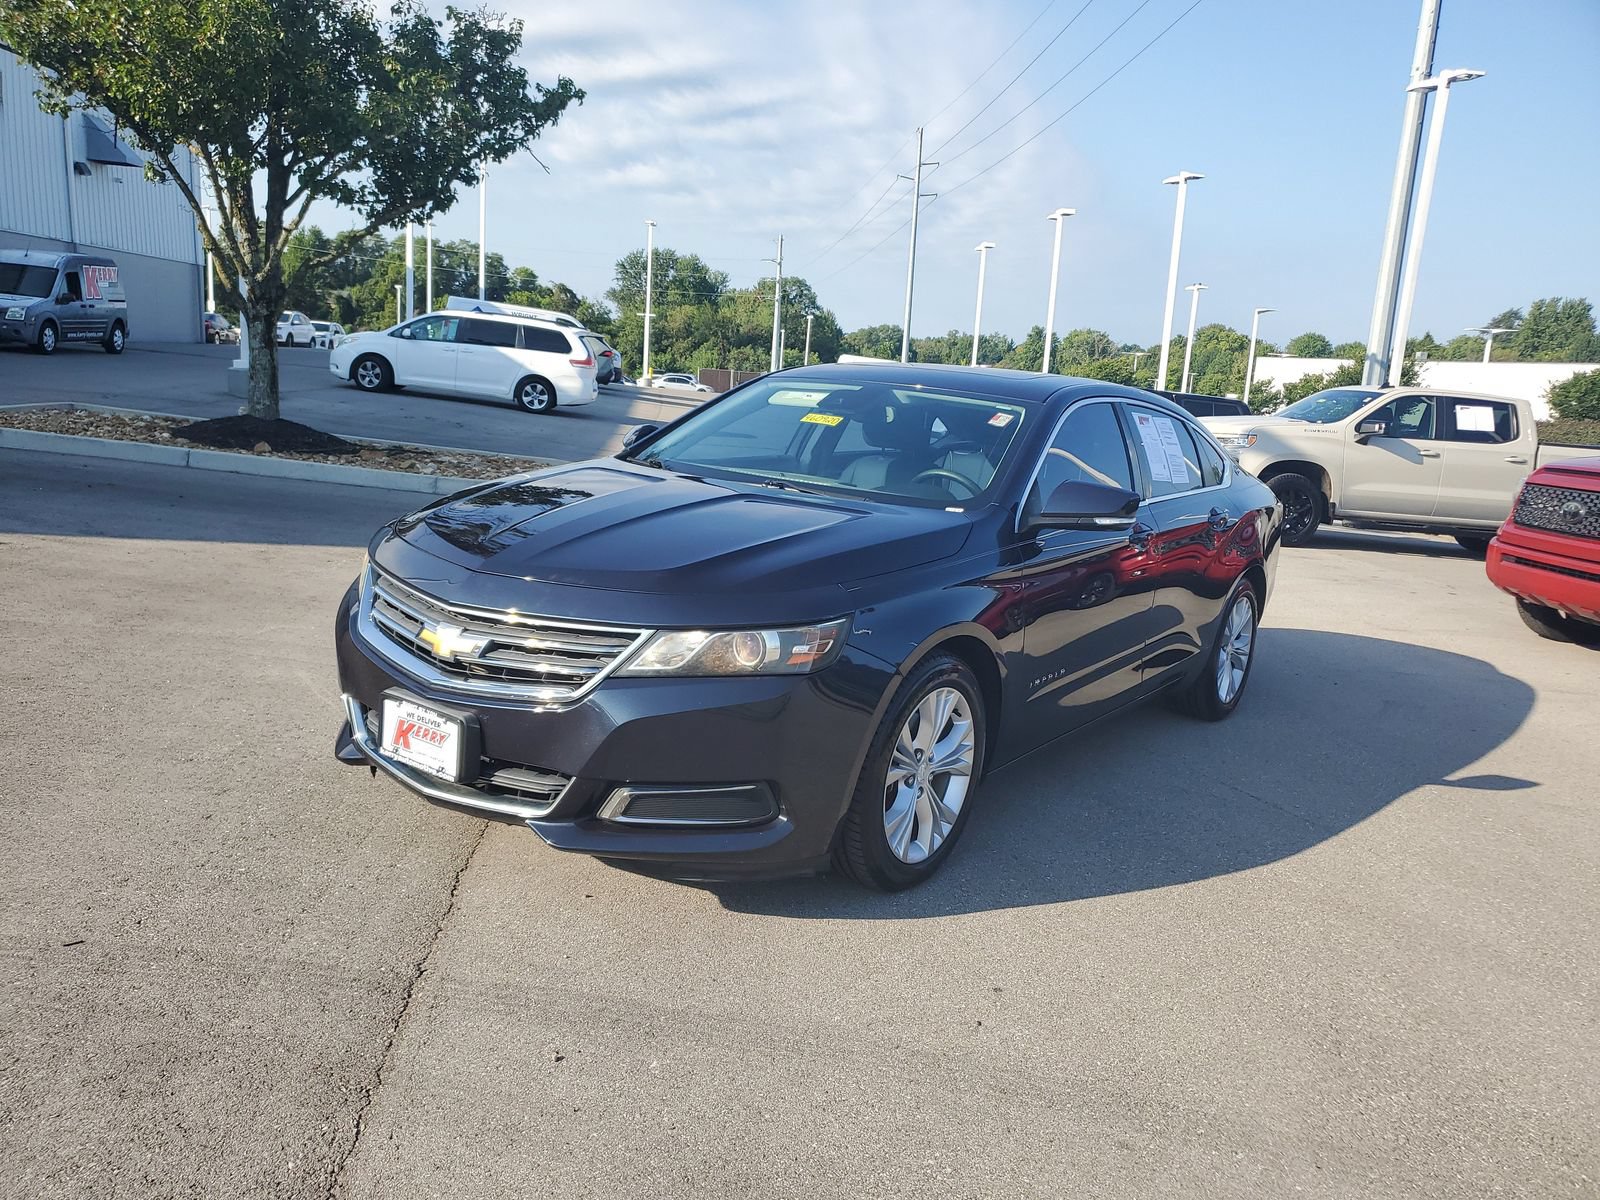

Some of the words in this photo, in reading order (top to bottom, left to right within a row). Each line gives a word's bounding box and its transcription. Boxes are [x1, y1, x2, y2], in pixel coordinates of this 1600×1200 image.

[406, 711, 416, 719] WE
[416, 714, 442, 728] DELIVER
[391, 717, 450, 750] KERRY
